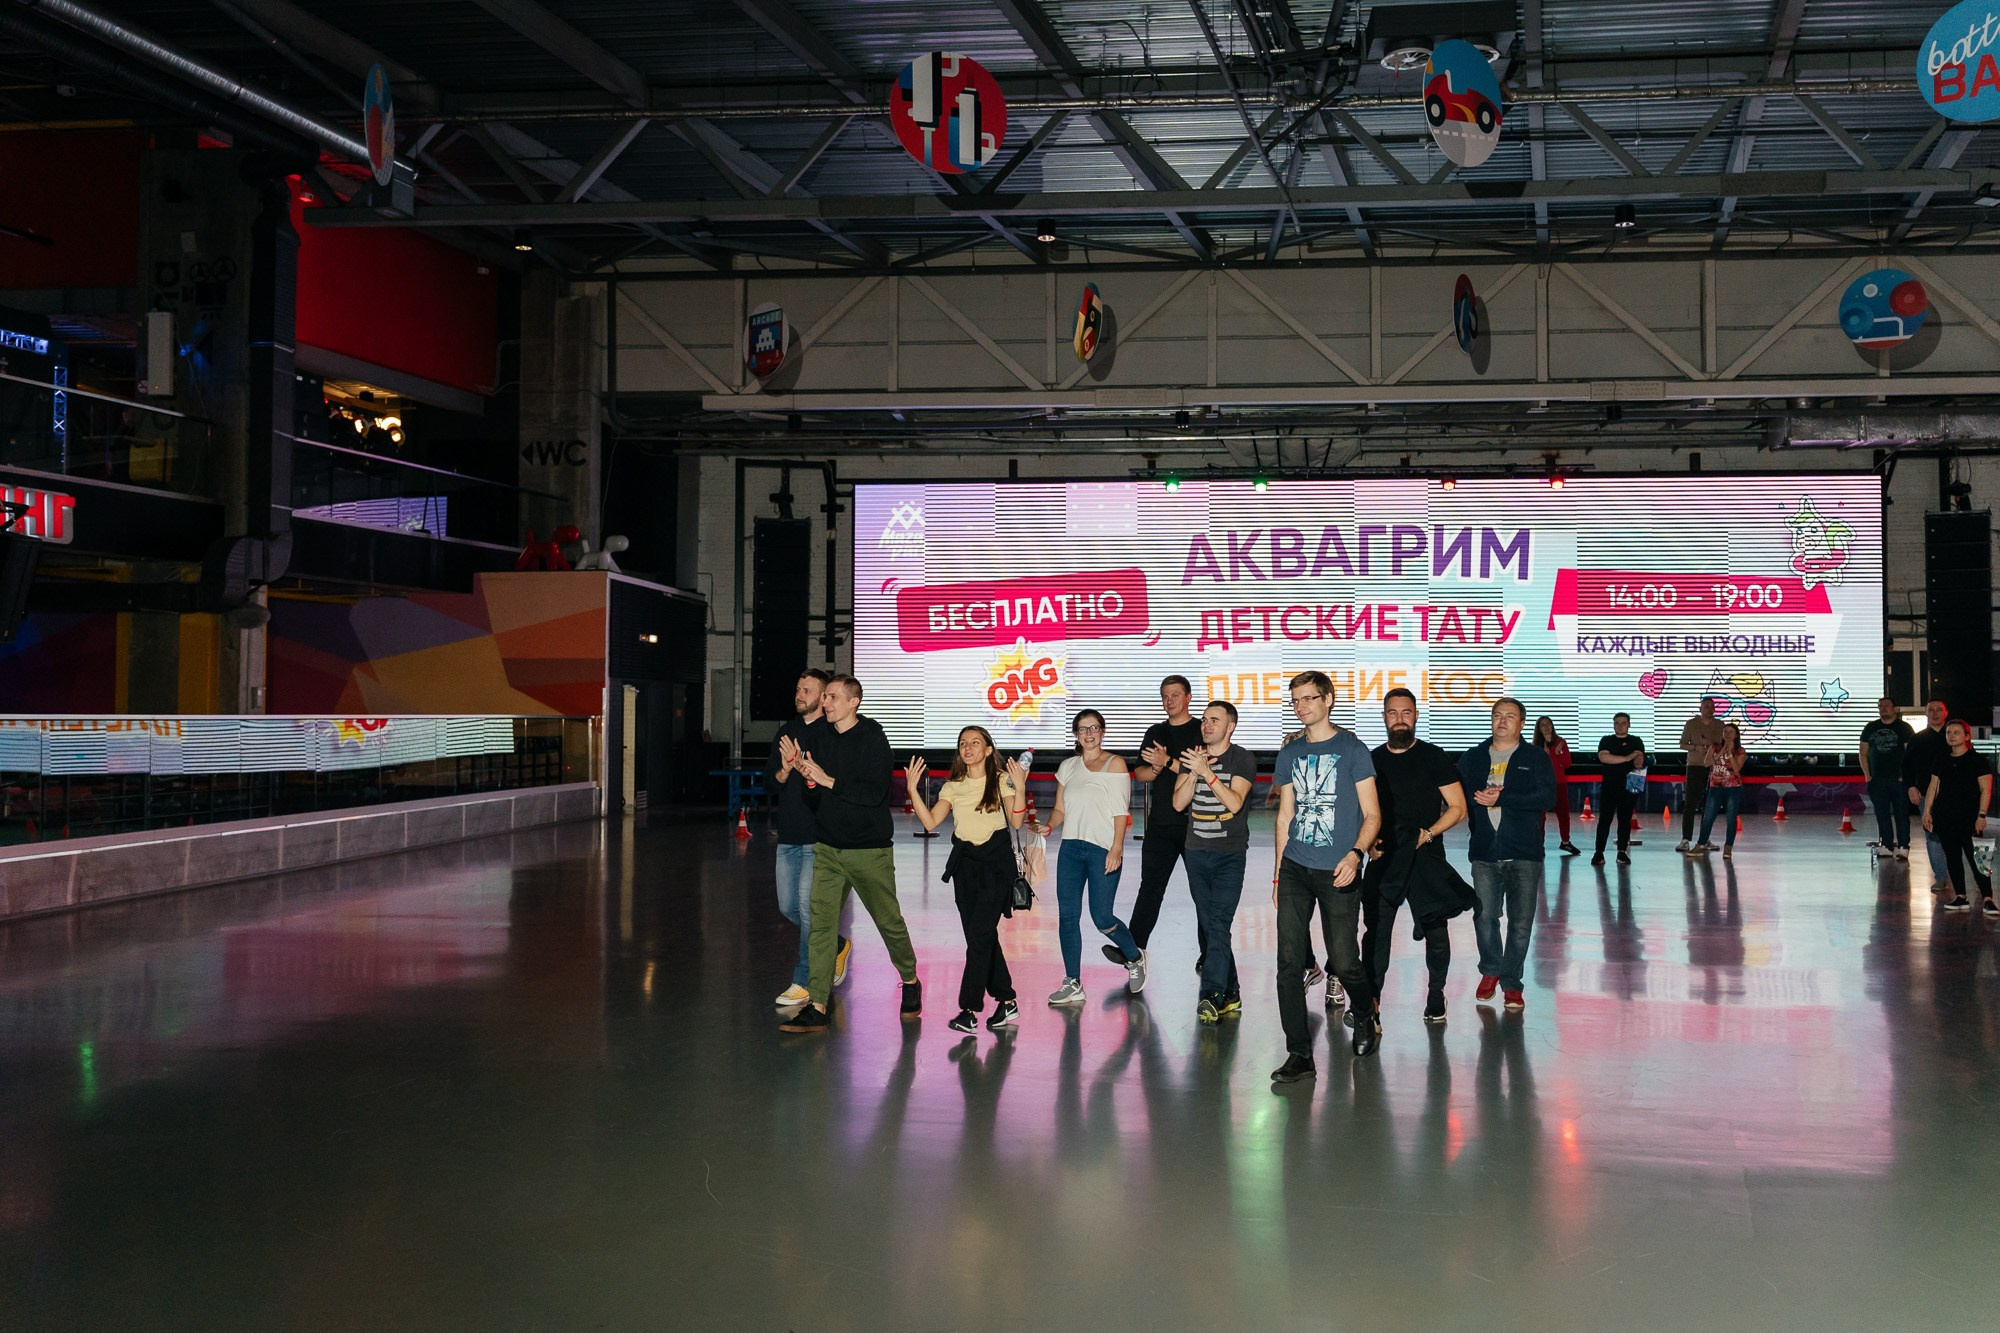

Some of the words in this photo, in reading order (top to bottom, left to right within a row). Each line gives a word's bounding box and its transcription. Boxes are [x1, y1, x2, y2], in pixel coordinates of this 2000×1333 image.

[1928, 12, 2000, 76] bott
[752, 311, 780, 326] ARCADE
[536, 440, 587, 466] WC
[0, 485, 76, 538] НГ
[1180, 524, 1531, 586] АКВАГРИМ
[927, 590, 1124, 633] БЕСПЛАТНО
[1605, 583, 1678, 609] 14:00
[1710, 583, 1783, 609] 19:00
[1197, 604, 1399, 653] ДЕТСКИЕ
[1412, 605, 1521, 645] ТАТУ
[1576, 634, 1678, 656] КАЖДЫЕ
[1684, 634, 1816, 656] ВЫХОДНЫЕ
[987, 656, 1059, 711] OMG
[1207, 669, 1407, 706] ПЛЕНИЕ
[1421, 670, 1508, 705] КОС
